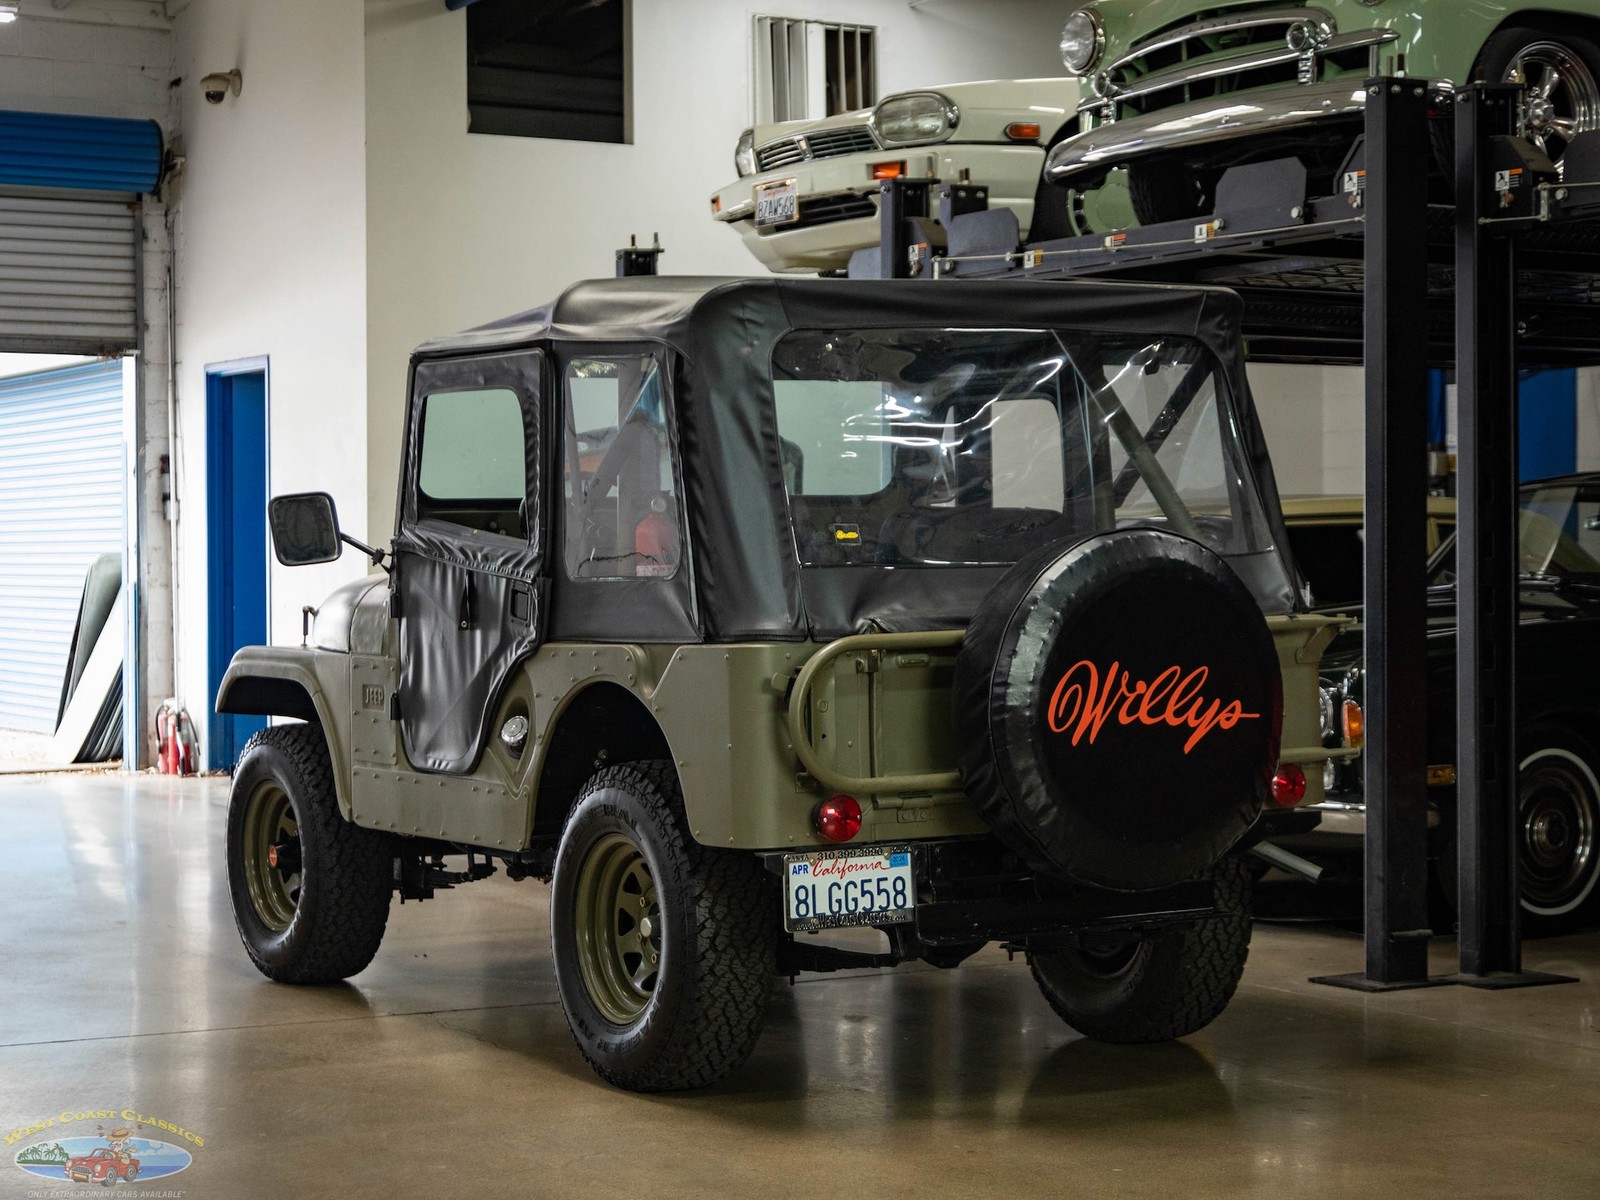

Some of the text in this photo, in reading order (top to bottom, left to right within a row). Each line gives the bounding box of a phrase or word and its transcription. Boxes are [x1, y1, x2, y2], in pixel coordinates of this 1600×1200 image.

[758, 195, 795, 219] 8ZAW568
[365, 687, 384, 705] JEEP
[1048, 660, 1260, 754] Willys
[817, 848, 883, 860] 310.399.3990
[792, 864, 809, 875] APR
[812, 858, 890, 880] California
[794, 875, 907, 918] 8LGG558
